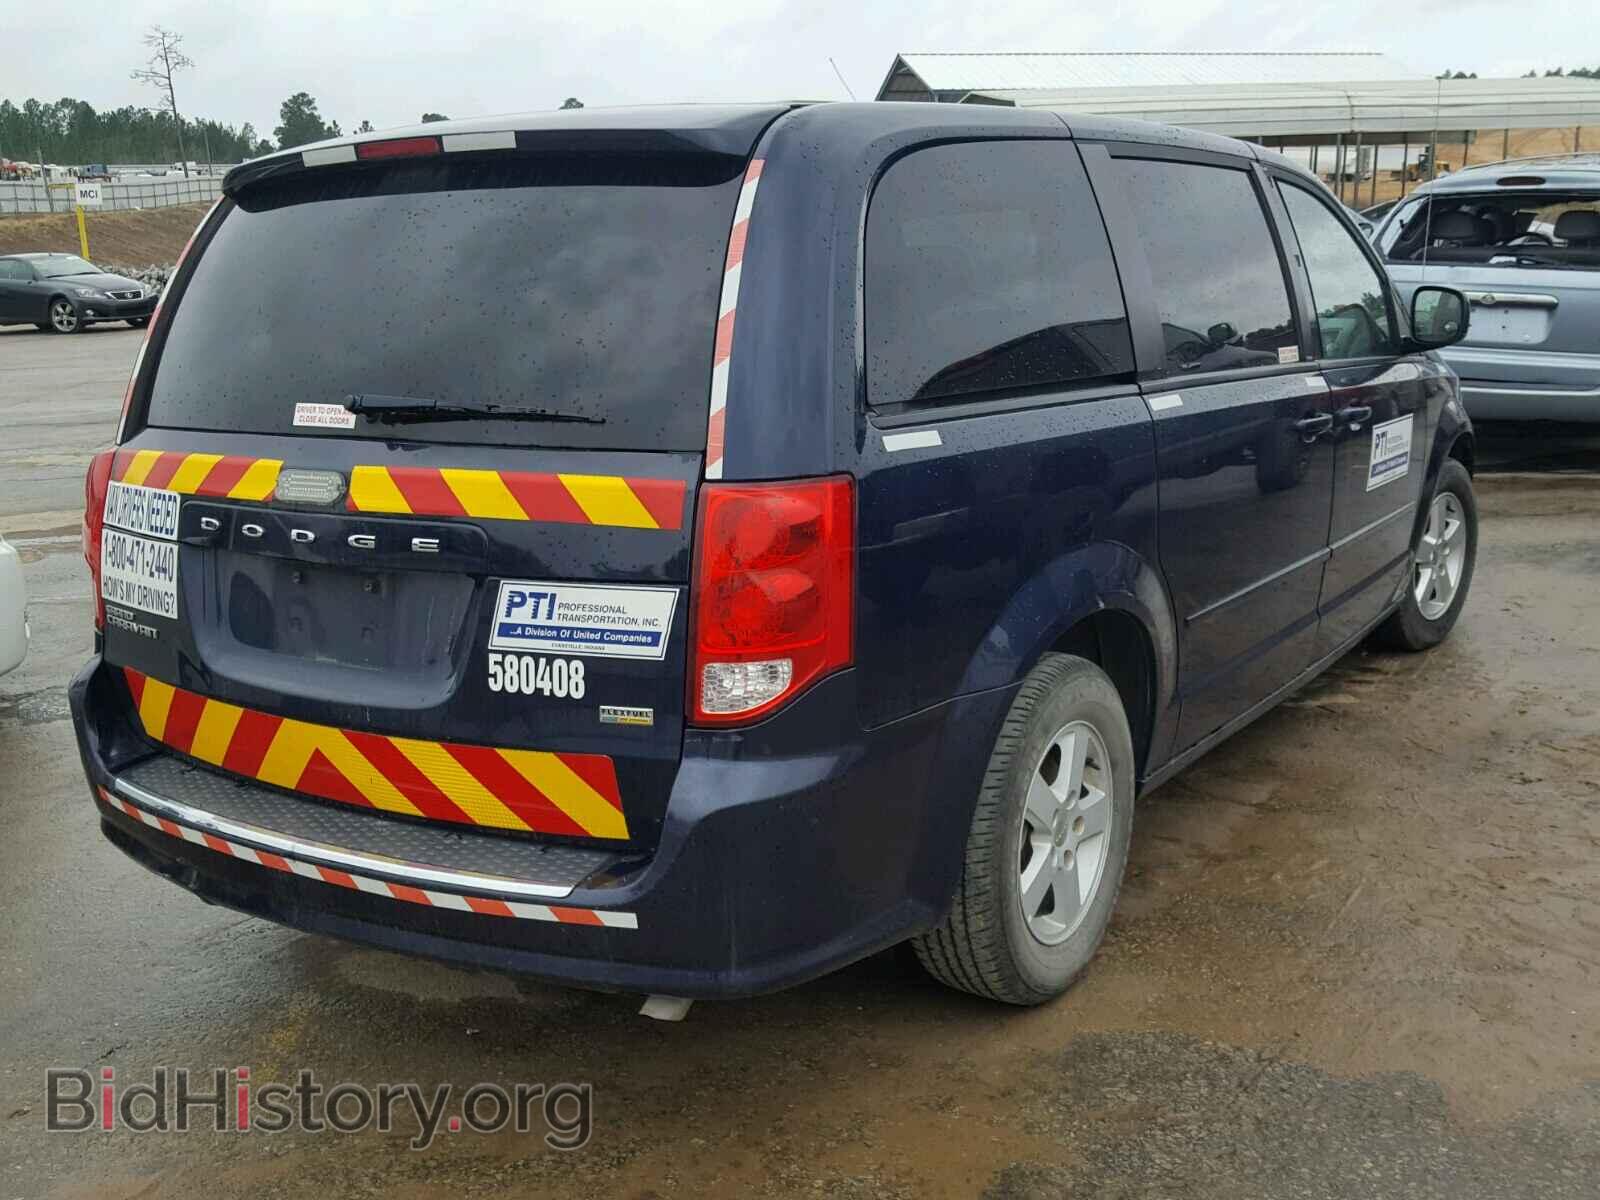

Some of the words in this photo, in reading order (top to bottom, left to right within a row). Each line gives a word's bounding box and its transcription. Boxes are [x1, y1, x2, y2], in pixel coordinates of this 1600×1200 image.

[79, 189, 98, 199] MCI
[319, 406, 326, 415] TO
[1373, 430, 1388, 460] PTI
[144, 491, 178, 536] NEEDED
[200, 516, 440, 553] DODGE
[103, 531, 175, 583] 1-800-471-2440
[103, 574, 124, 601] HOW'S
[125, 580, 137, 605] MY
[137, 584, 175, 615] DRIVING?
[504, 590, 557, 621] PTI
[557, 602, 628, 615] PROFESSIONAL
[556, 612, 640, 627] TRANSPORTATION,
[641, 617, 662, 628] INC.
[524, 627, 558, 638] Division
[559, 628, 572, 639] Of
[573, 630, 601, 641] United
[603, 631, 653, 644] Companies
[487, 653, 586, 700] 580408
